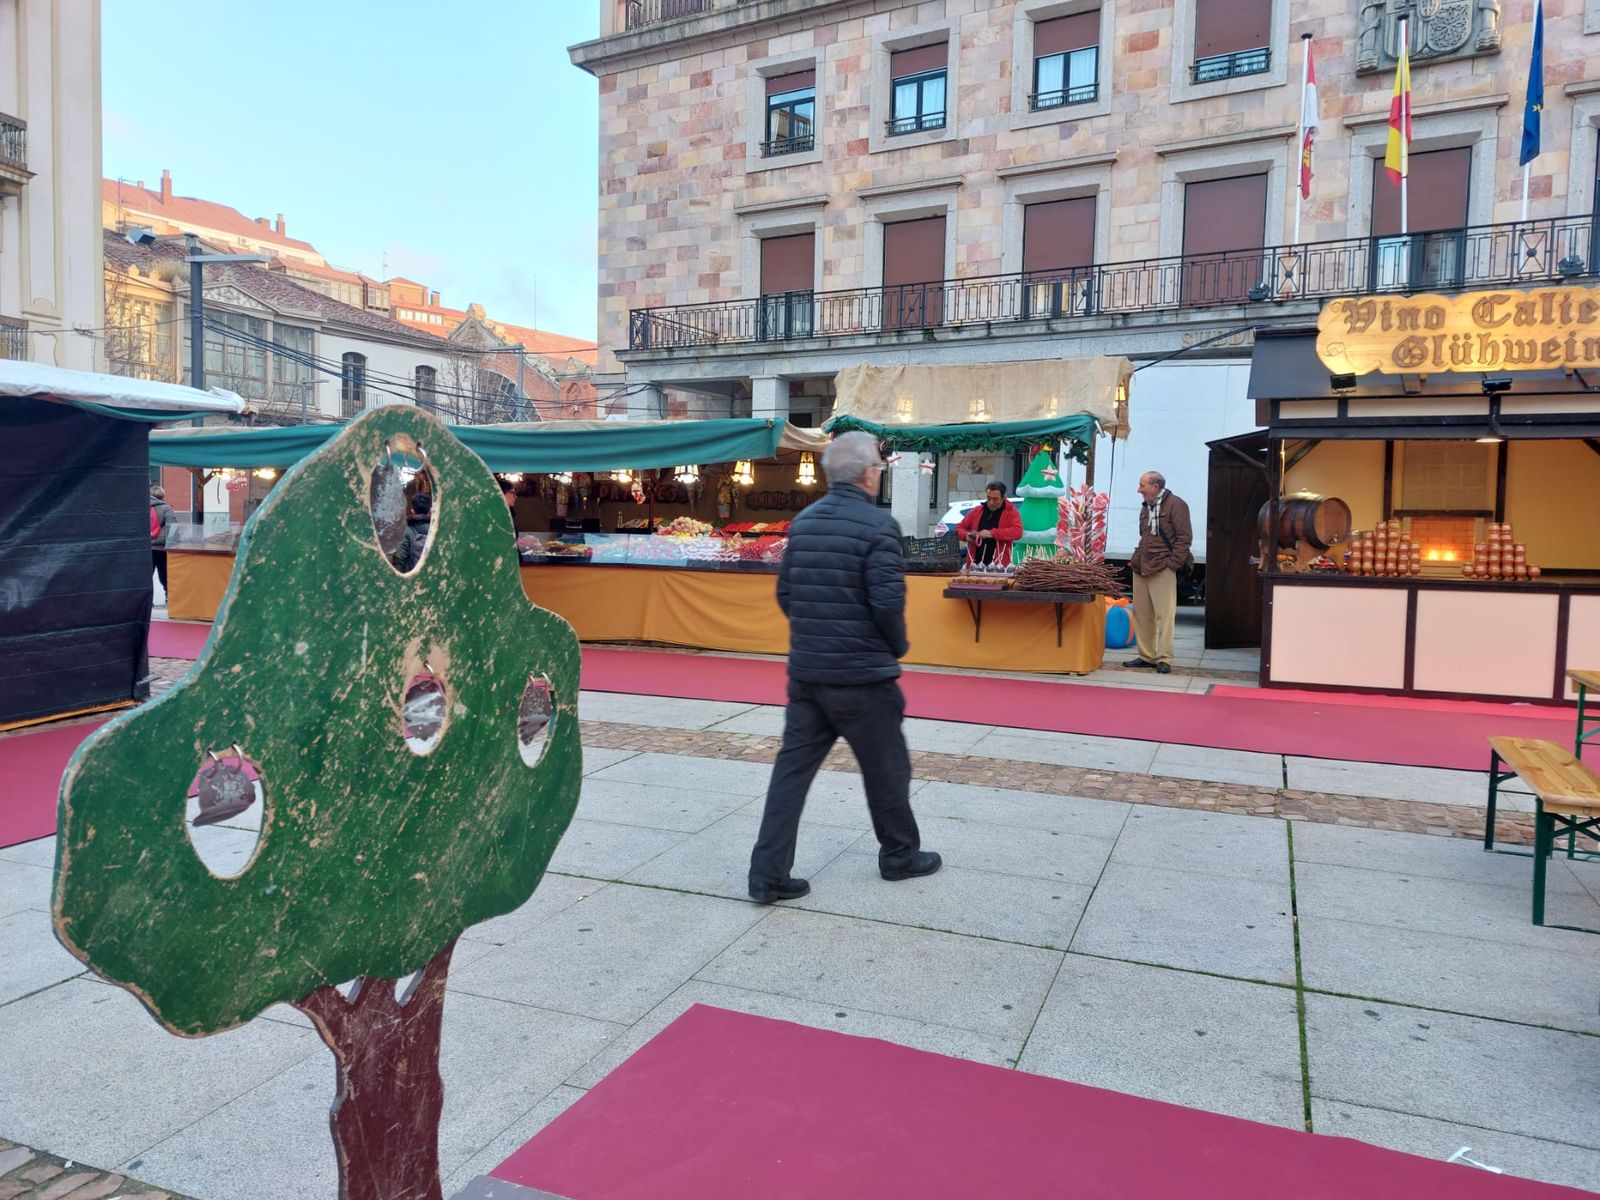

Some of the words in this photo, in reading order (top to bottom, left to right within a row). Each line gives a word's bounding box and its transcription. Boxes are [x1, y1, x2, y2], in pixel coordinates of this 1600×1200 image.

[1341, 299, 1447, 335] Vino
[1471, 291, 1600, 329] Calie
[1392, 331, 1600, 368] Glühwein
